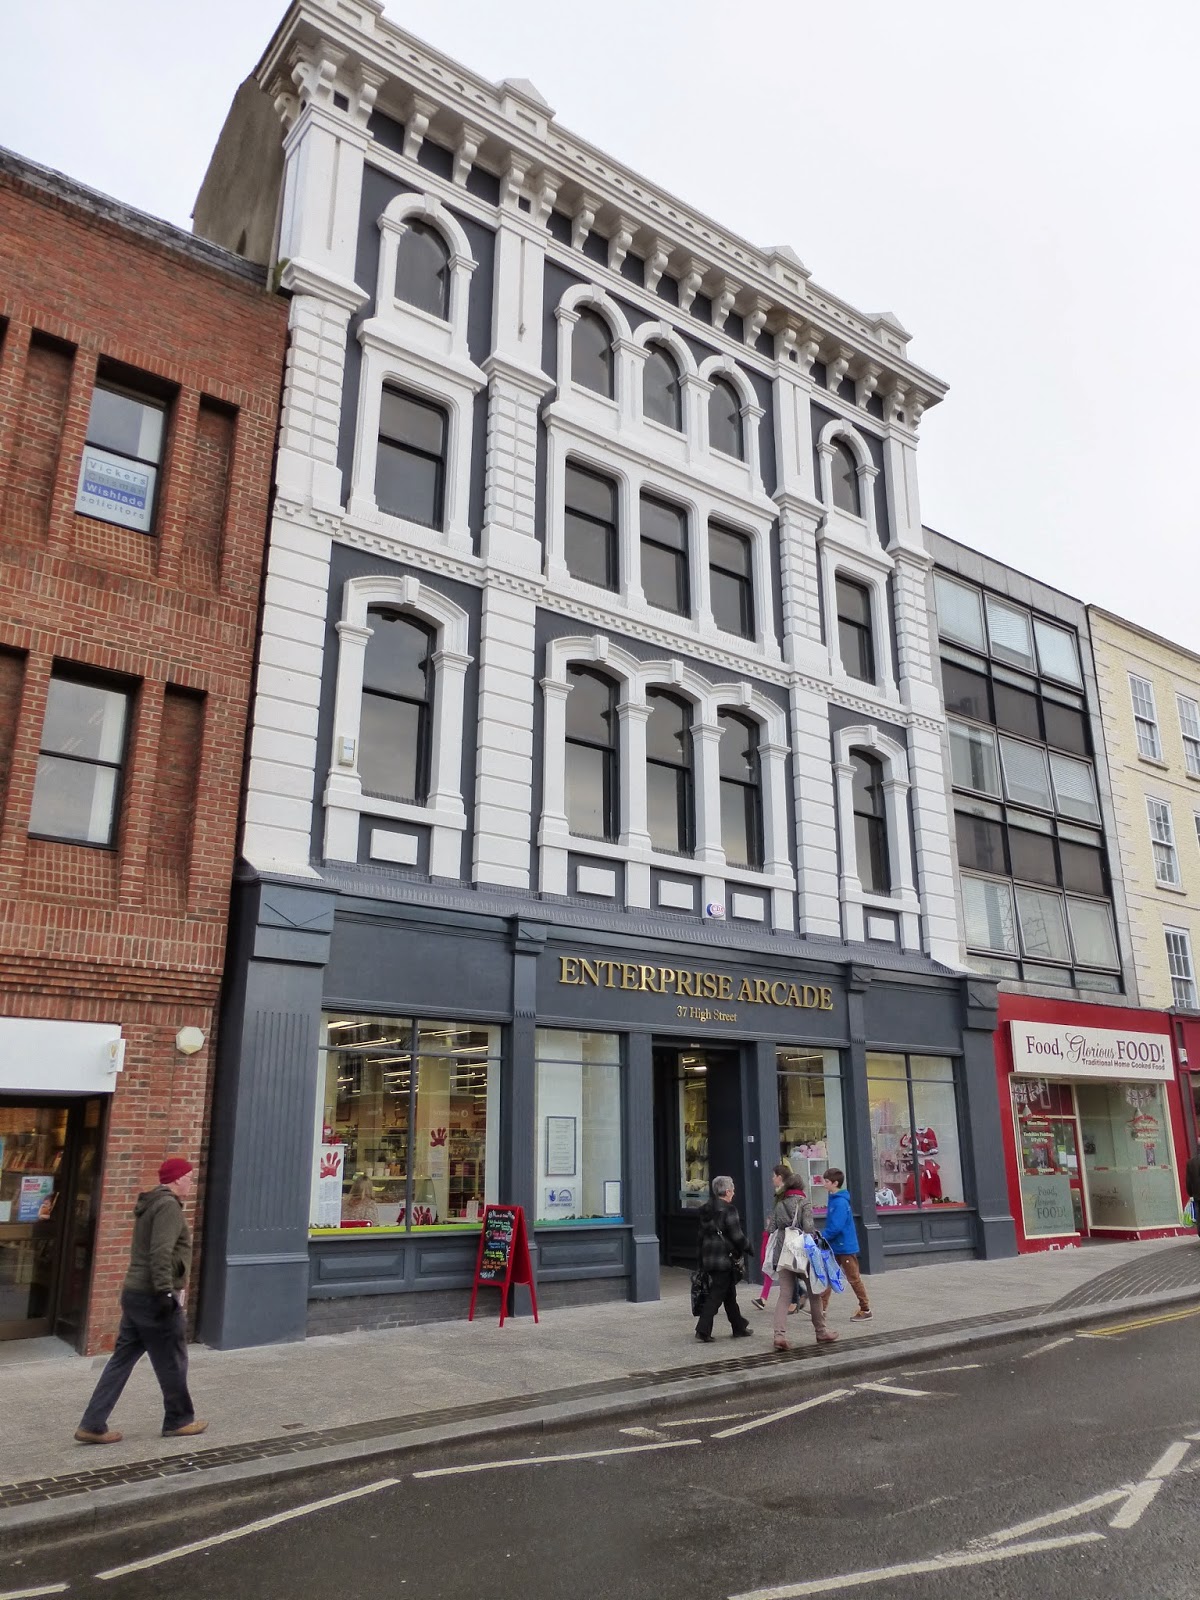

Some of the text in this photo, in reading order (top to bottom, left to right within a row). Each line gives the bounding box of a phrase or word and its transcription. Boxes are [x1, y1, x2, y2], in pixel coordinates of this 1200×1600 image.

[89, 461, 146, 486] Vickers
[86, 482, 143, 507] Wishlade
[80, 495, 144, 520] solicitors
[559, 956, 833, 1011] ENTERPRISE ARCADE
[677, 1005, 737, 1022] 37 High Street
[1026, 1032, 1165, 1063] Food, Glorious FOOD!
[1082, 1058, 1113, 1067] Traditional
[1114, 1060, 1130, 1068] Home
[1131, 1061, 1151, 1070] Cooked
